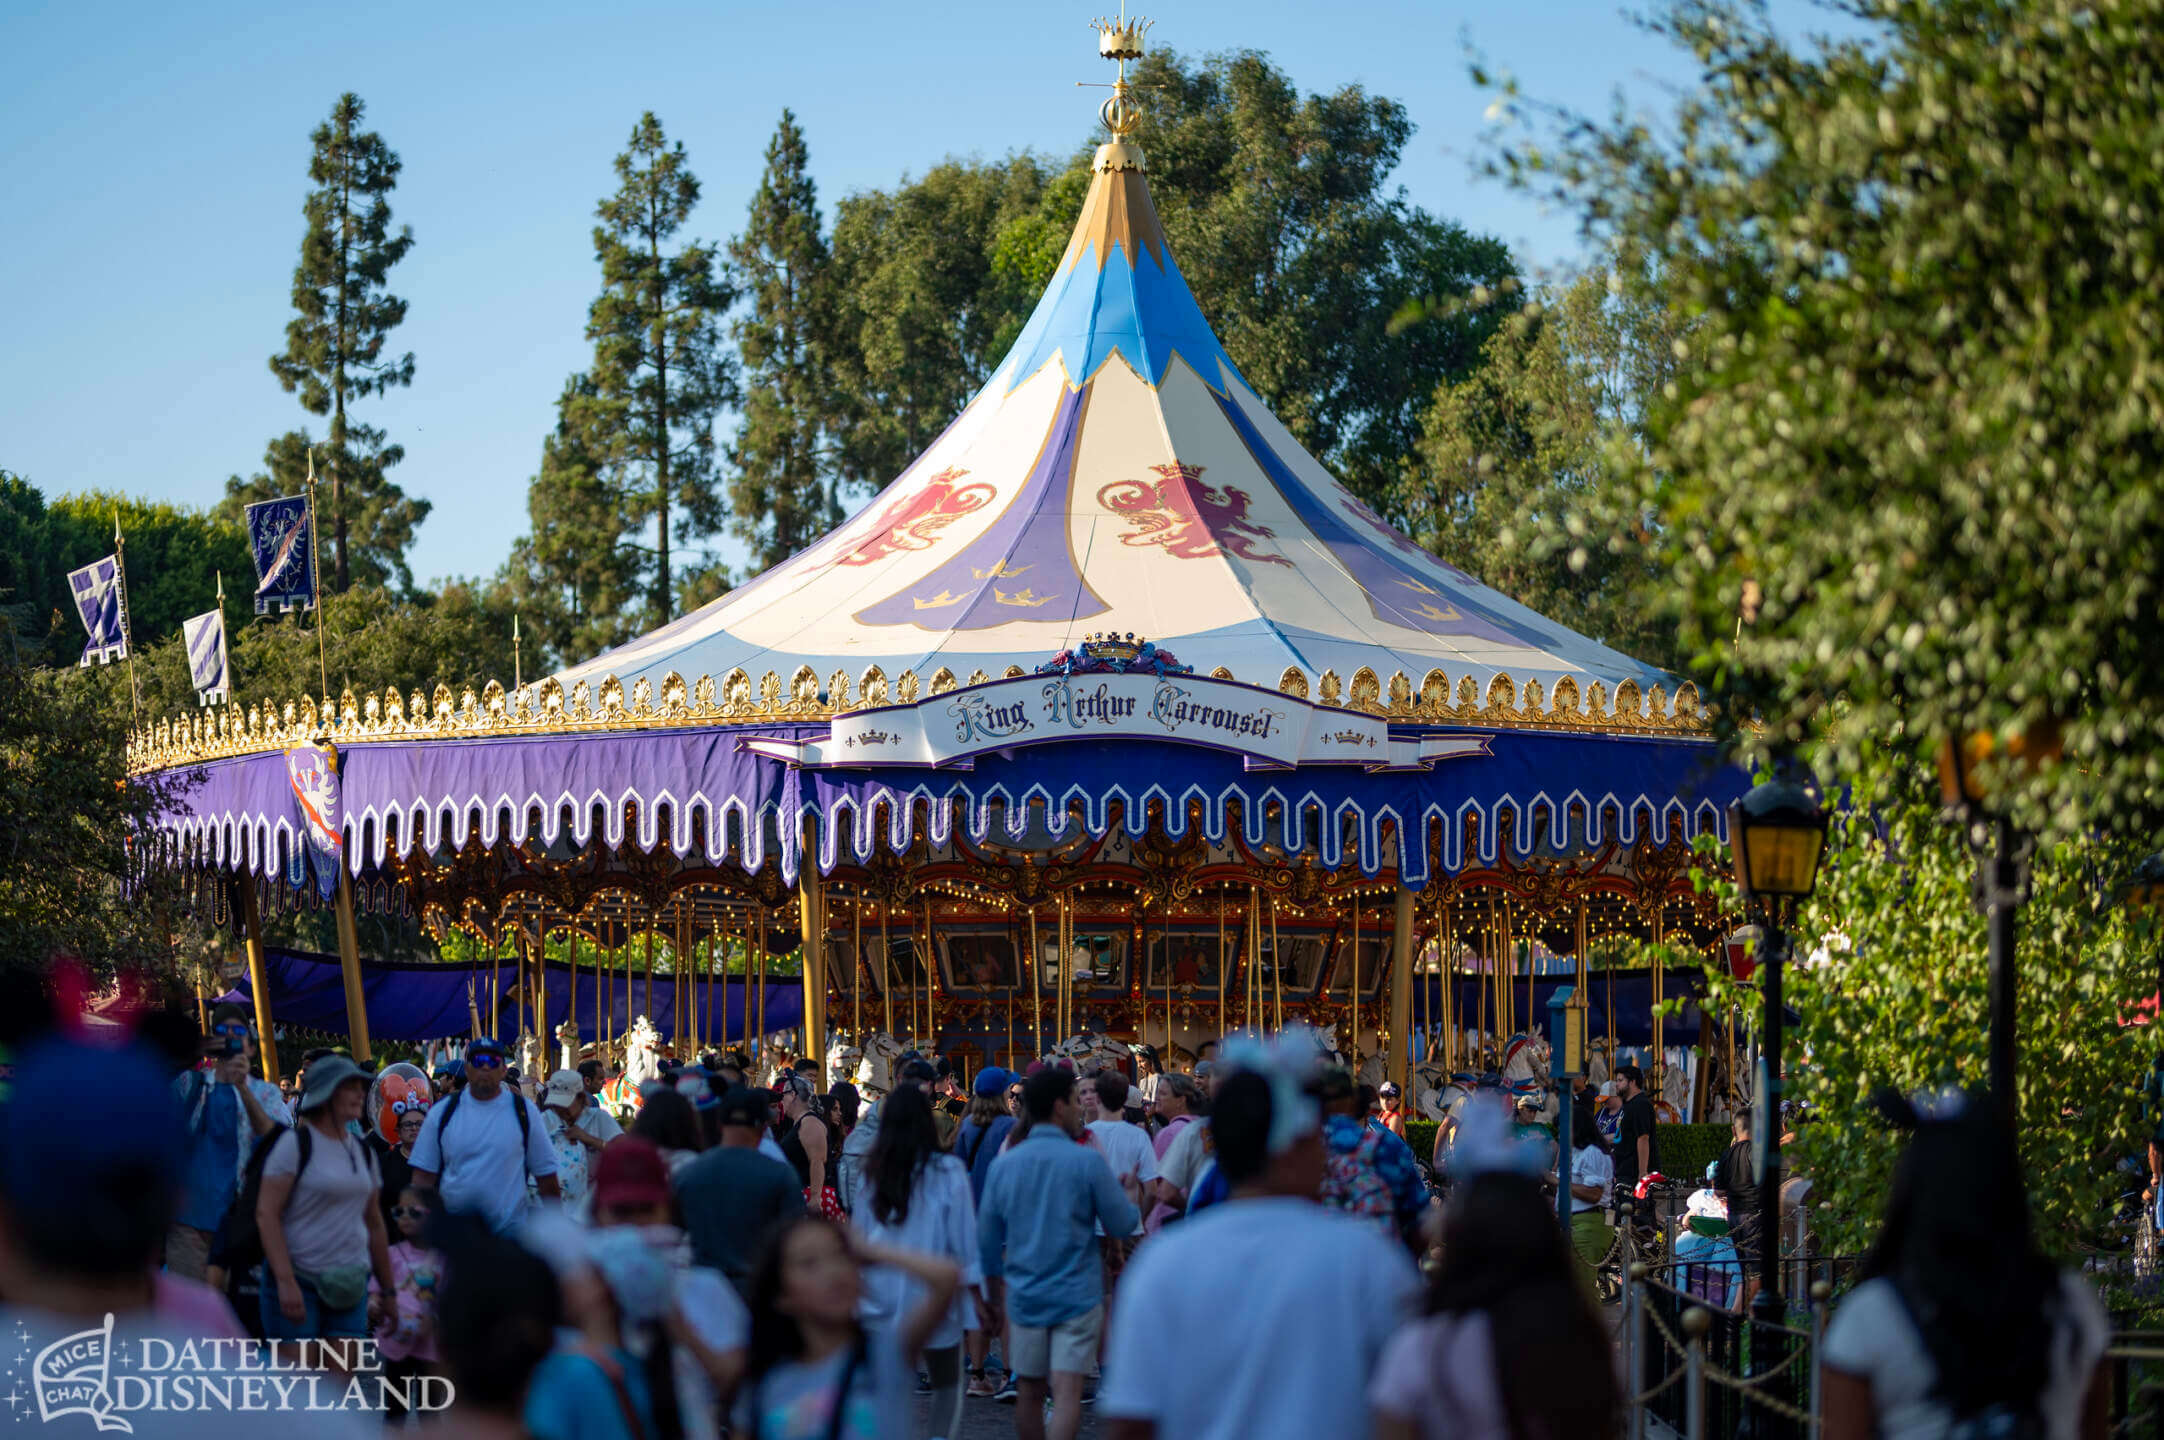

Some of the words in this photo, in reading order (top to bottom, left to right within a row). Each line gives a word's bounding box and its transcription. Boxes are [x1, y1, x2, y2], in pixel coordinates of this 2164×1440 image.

[947, 692, 1035, 743] King
[1042, 681, 1136, 729] Arthur
[1148, 681, 1286, 740] Carrousel
